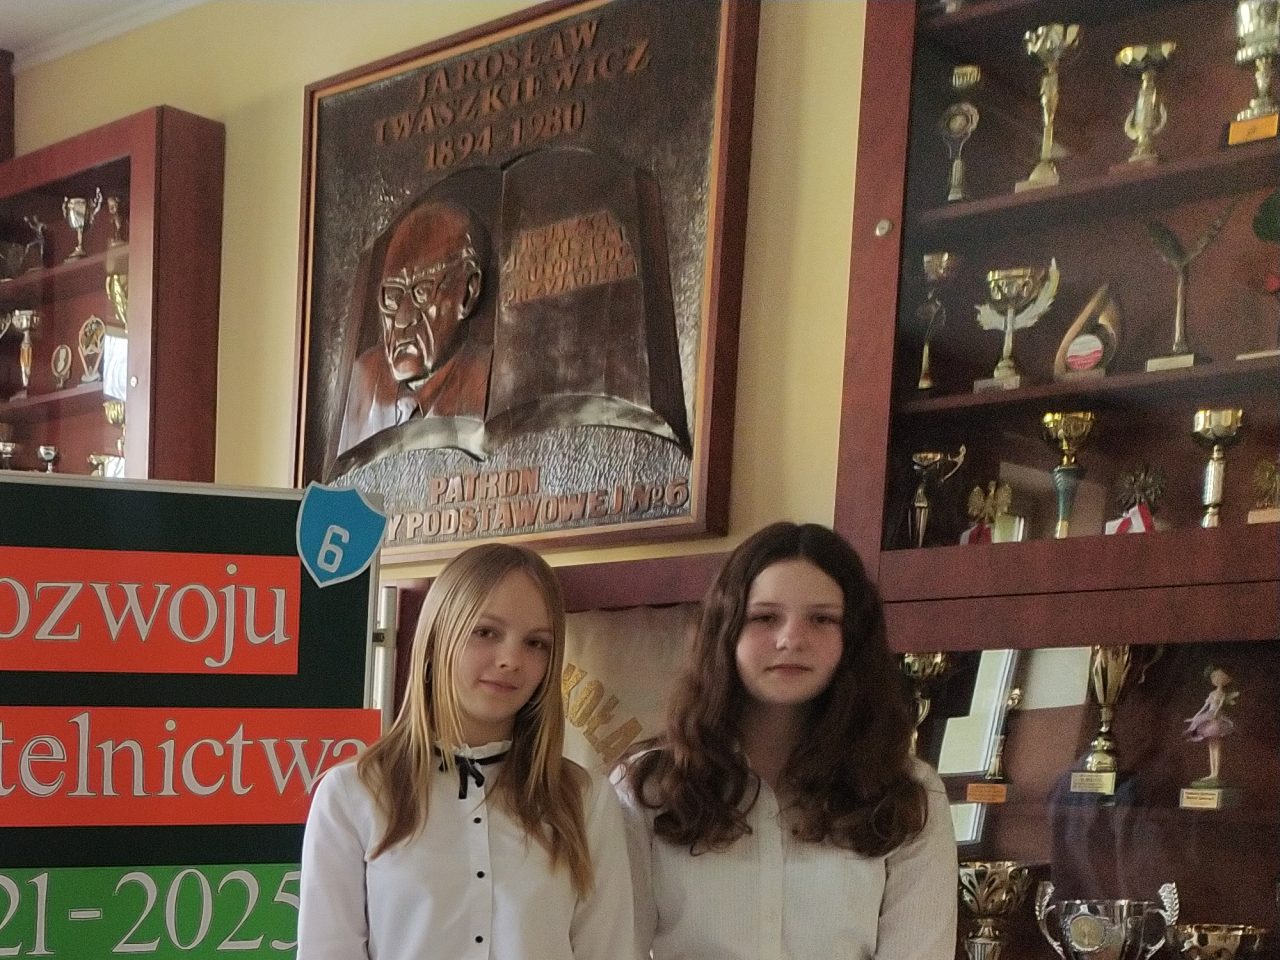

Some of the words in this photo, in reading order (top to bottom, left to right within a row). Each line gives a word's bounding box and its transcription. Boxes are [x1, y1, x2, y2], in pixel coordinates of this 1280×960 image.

[420, 19, 598, 101] JAROSŁAW
[375, 38, 649, 146] IWASZKIEWICZ
[426, 126, 494, 172] 1894
[511, 101, 586, 148] 1980
[405, 484, 624, 538] PODSTAWOWEJ
[429, 466, 541, 505] PATRON
[317, 524, 351, 574] 6
